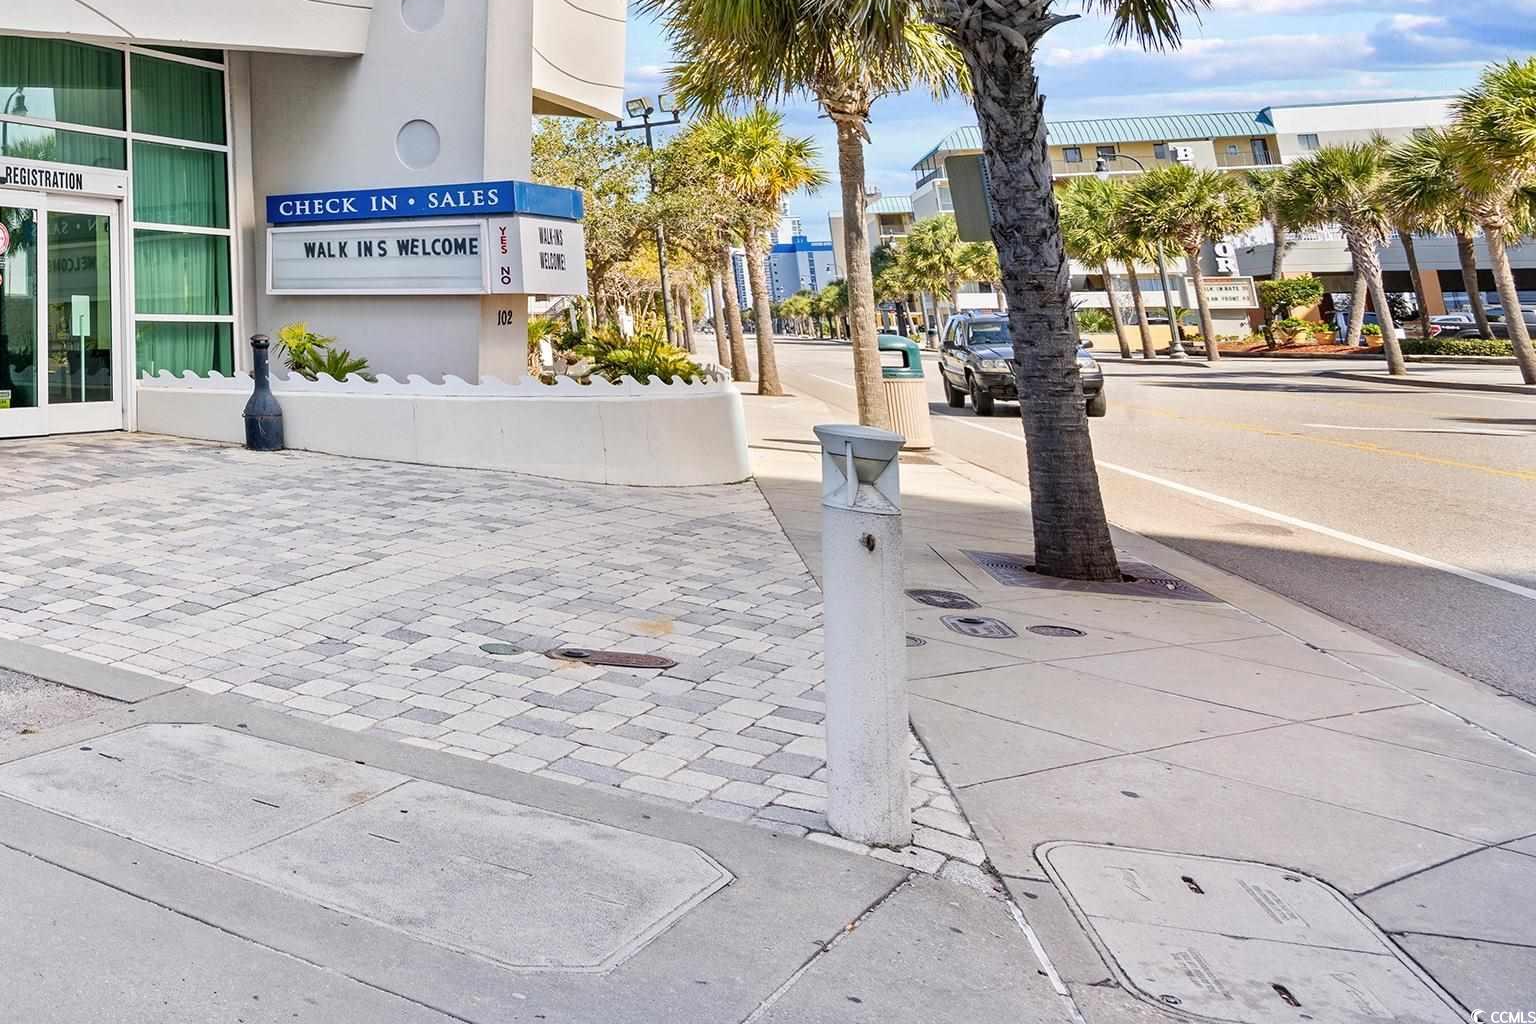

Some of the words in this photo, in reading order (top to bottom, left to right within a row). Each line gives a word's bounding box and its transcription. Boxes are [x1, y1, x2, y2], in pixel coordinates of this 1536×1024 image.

[5, 166, 83, 191] REGISTRATION
[279, 197, 358, 216] CHECK
[370, 195, 398, 212] IN
[428, 189, 499, 209] SALES
[304, 241, 348, 258] WALK
[396, 237, 478, 256] WELCOME
[499, 227, 508, 254] YES
[500, 266, 511, 285] NO
[497, 310, 513, 326] 102
